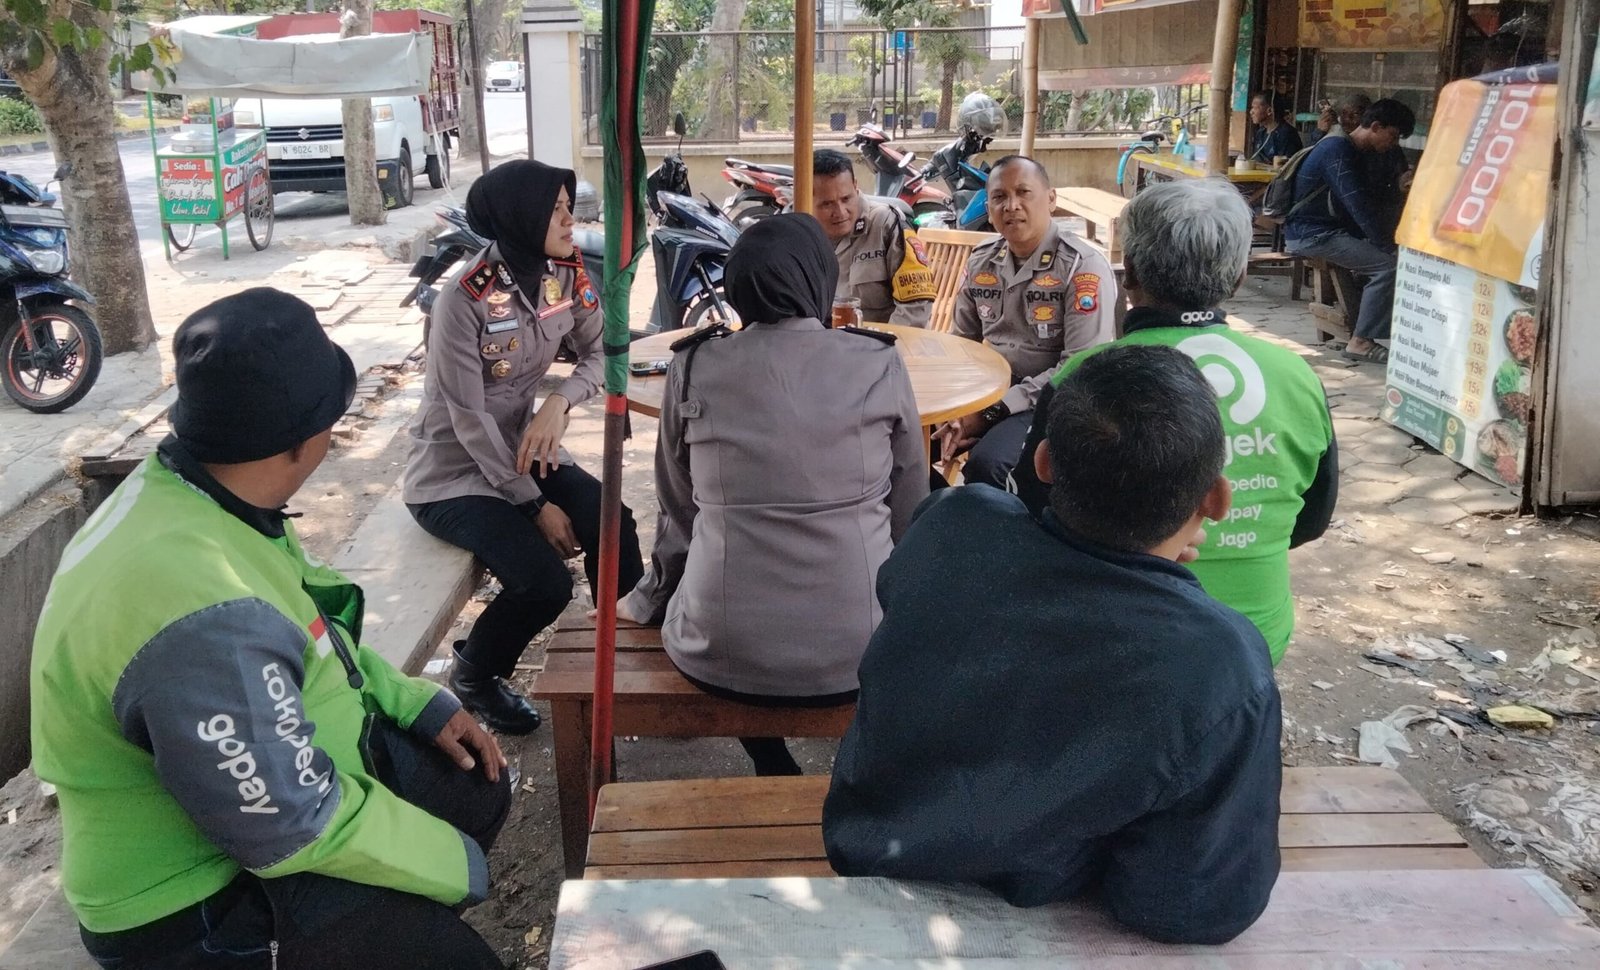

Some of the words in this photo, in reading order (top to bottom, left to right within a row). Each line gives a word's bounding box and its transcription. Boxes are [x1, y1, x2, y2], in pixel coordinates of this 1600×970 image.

[1460, 90, 1500, 165] Batang
[1456, 85, 1536, 226] 10.000
[695, 225, 719, 239] HONDA
[1405, 262, 1417, 274] Nasi
[1403, 280, 1415, 292] Nasi
[1401, 298, 1413, 310] Nasi
[1400, 316, 1411, 328] Nasi
[1397, 333, 1409, 346] Nasi
[1423, 344, 1436, 359] Asap
[1396, 350, 1408, 364] Nasi
[1224, 427, 1278, 467] jek
[1217, 531, 1257, 548] Jago
[197, 713, 279, 814] gopay
